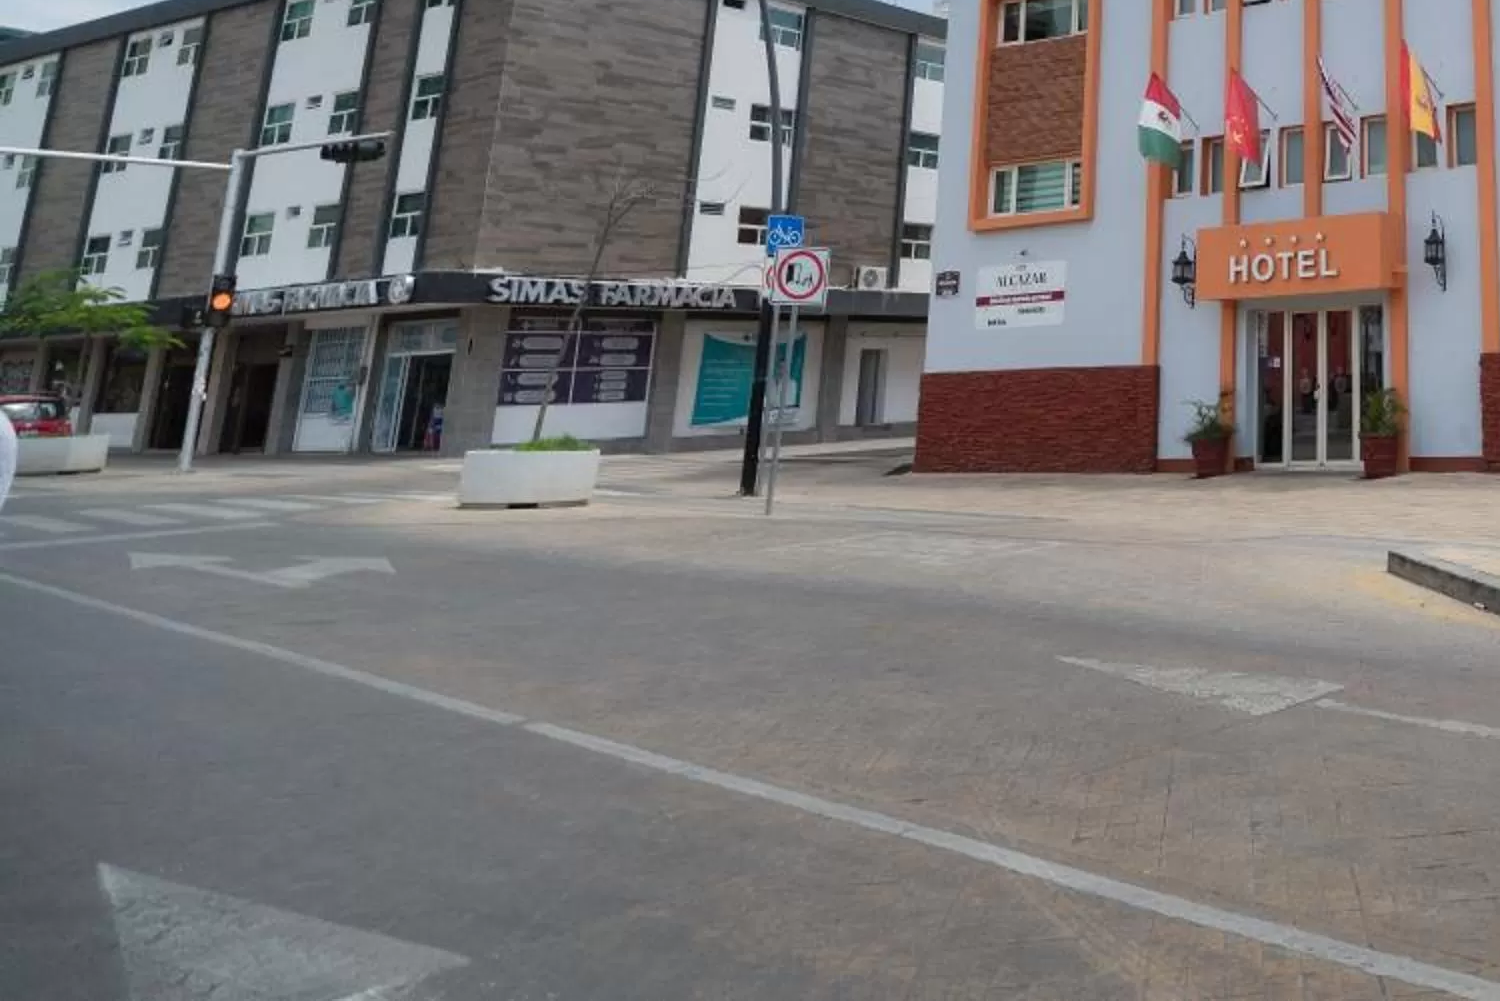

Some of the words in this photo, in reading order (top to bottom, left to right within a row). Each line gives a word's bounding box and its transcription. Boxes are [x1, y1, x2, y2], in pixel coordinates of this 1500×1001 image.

[1228, 247, 1339, 284] HOTEL
[489, 278, 586, 304] SIMAS
[601, 281, 737, 308] FARMACIA
